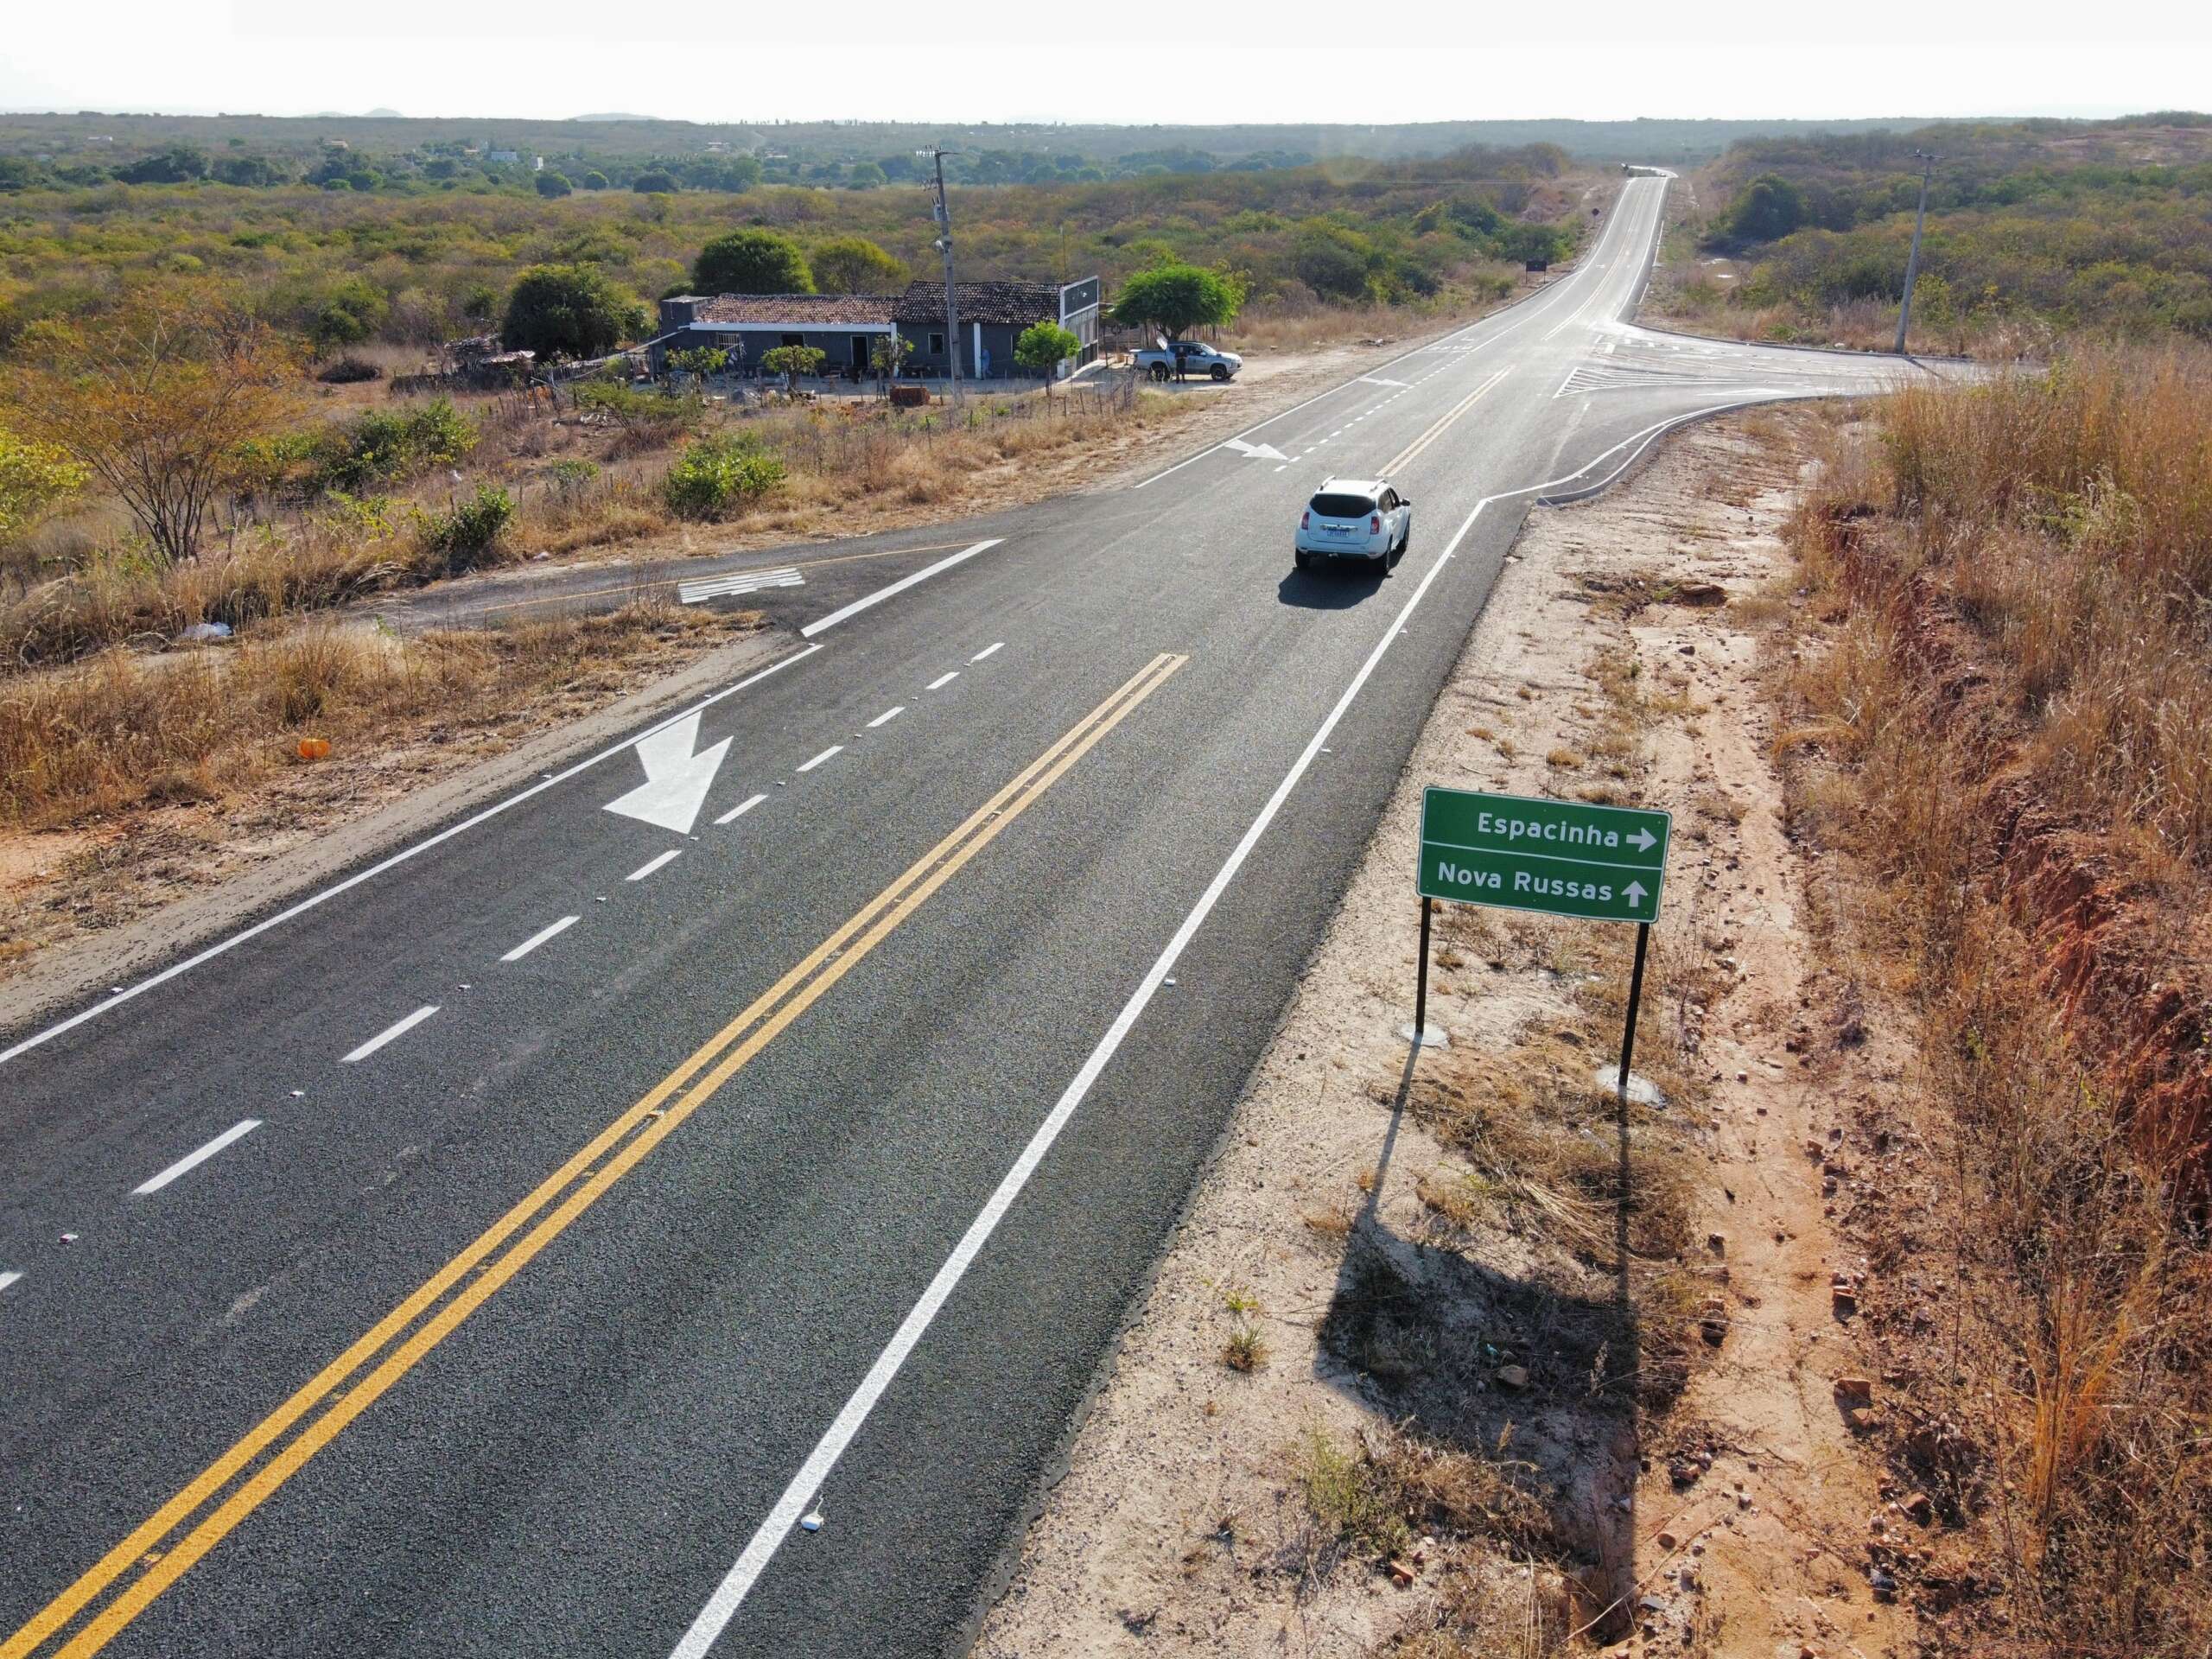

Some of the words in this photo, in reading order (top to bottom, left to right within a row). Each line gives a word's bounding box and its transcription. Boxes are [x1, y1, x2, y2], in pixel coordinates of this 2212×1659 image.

[1478, 812, 1618, 848] Espacinha
[1438, 861, 1502, 888] Nova
[1514, 871, 1612, 901] Russas
